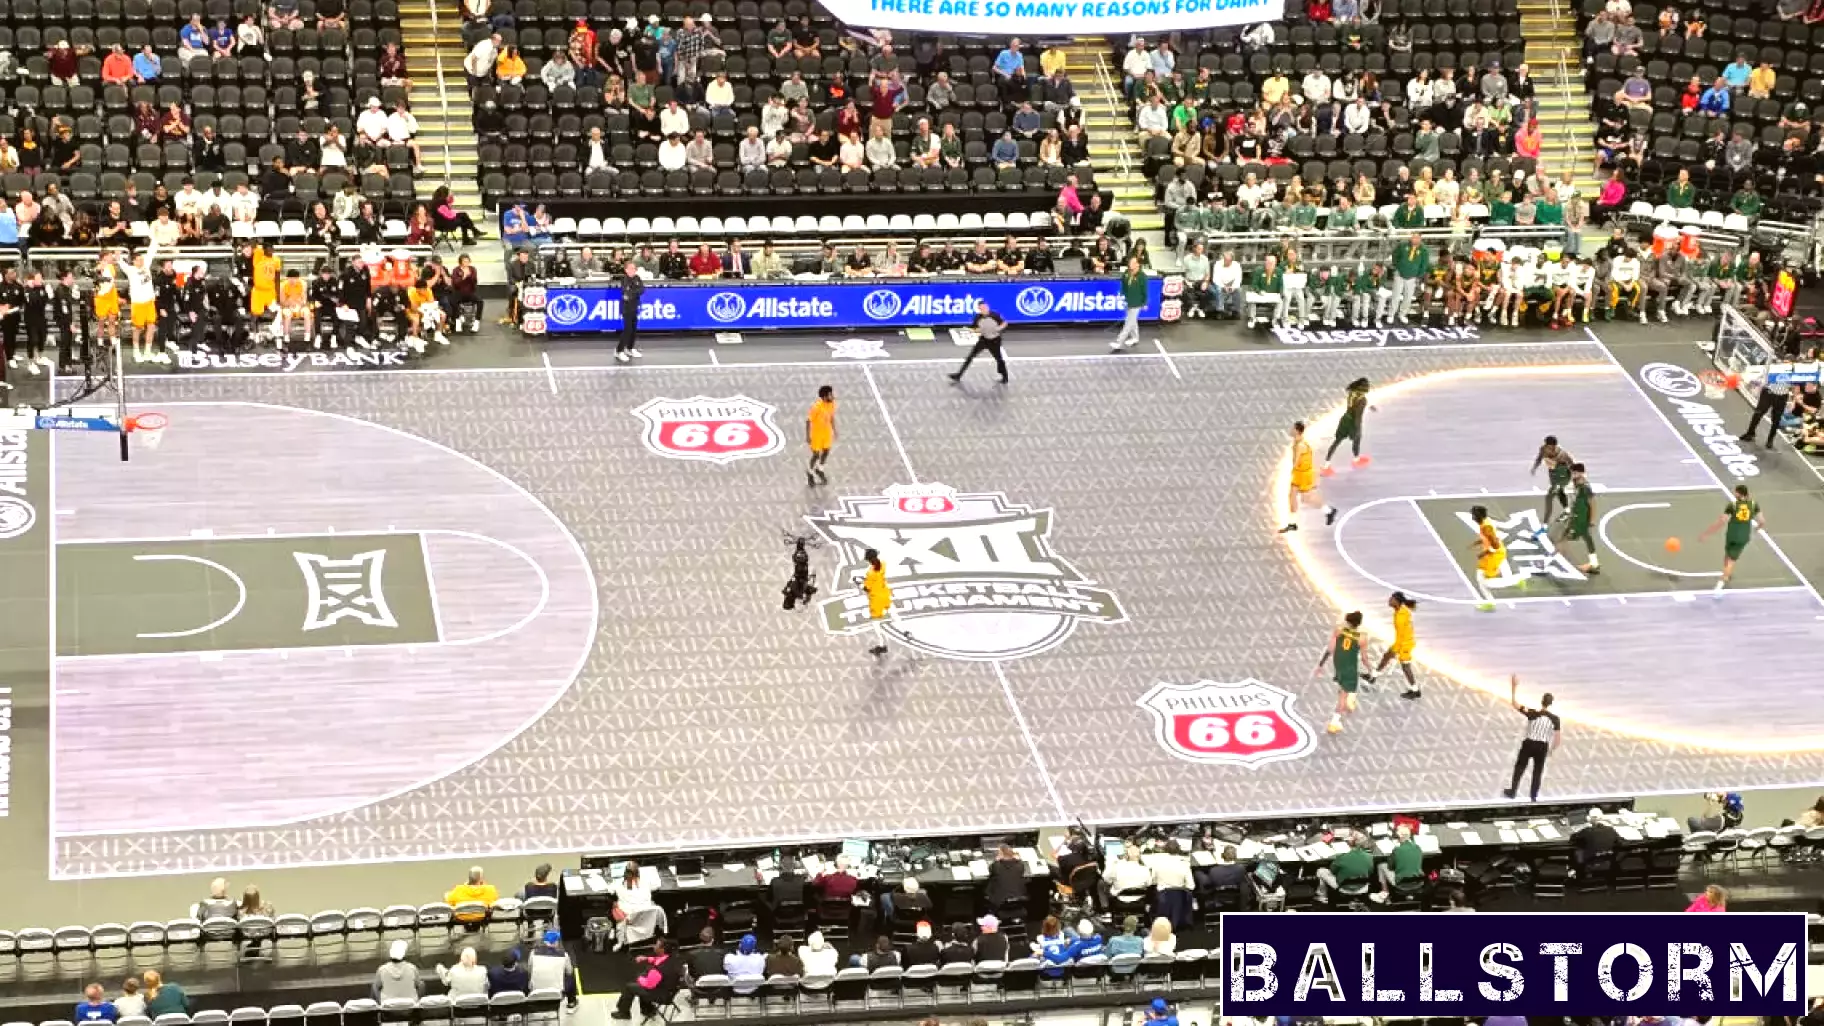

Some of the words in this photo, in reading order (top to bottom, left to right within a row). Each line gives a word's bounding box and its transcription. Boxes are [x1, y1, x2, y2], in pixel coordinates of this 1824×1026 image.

[938, 0, 980, 17] ARE
[984, 1, 1011, 18] SO
[1015, 2, 1078, 18] MANY
[1082, 1, 1170, 17] REASONS
[1175, 0, 1211, 14] FOR
[588, 298, 677, 320] Allate
[747, 297, 833, 318] Allstate
[658, 406, 753, 419] PHILLIPS
[671, 422, 751, 448] 66
[1667, 397, 1760, 478] Allstate
[904, 497, 945, 511] 66
[1165, 692, 1271, 710] PHILLIPS
[1188, 714, 1276, 748] 66
